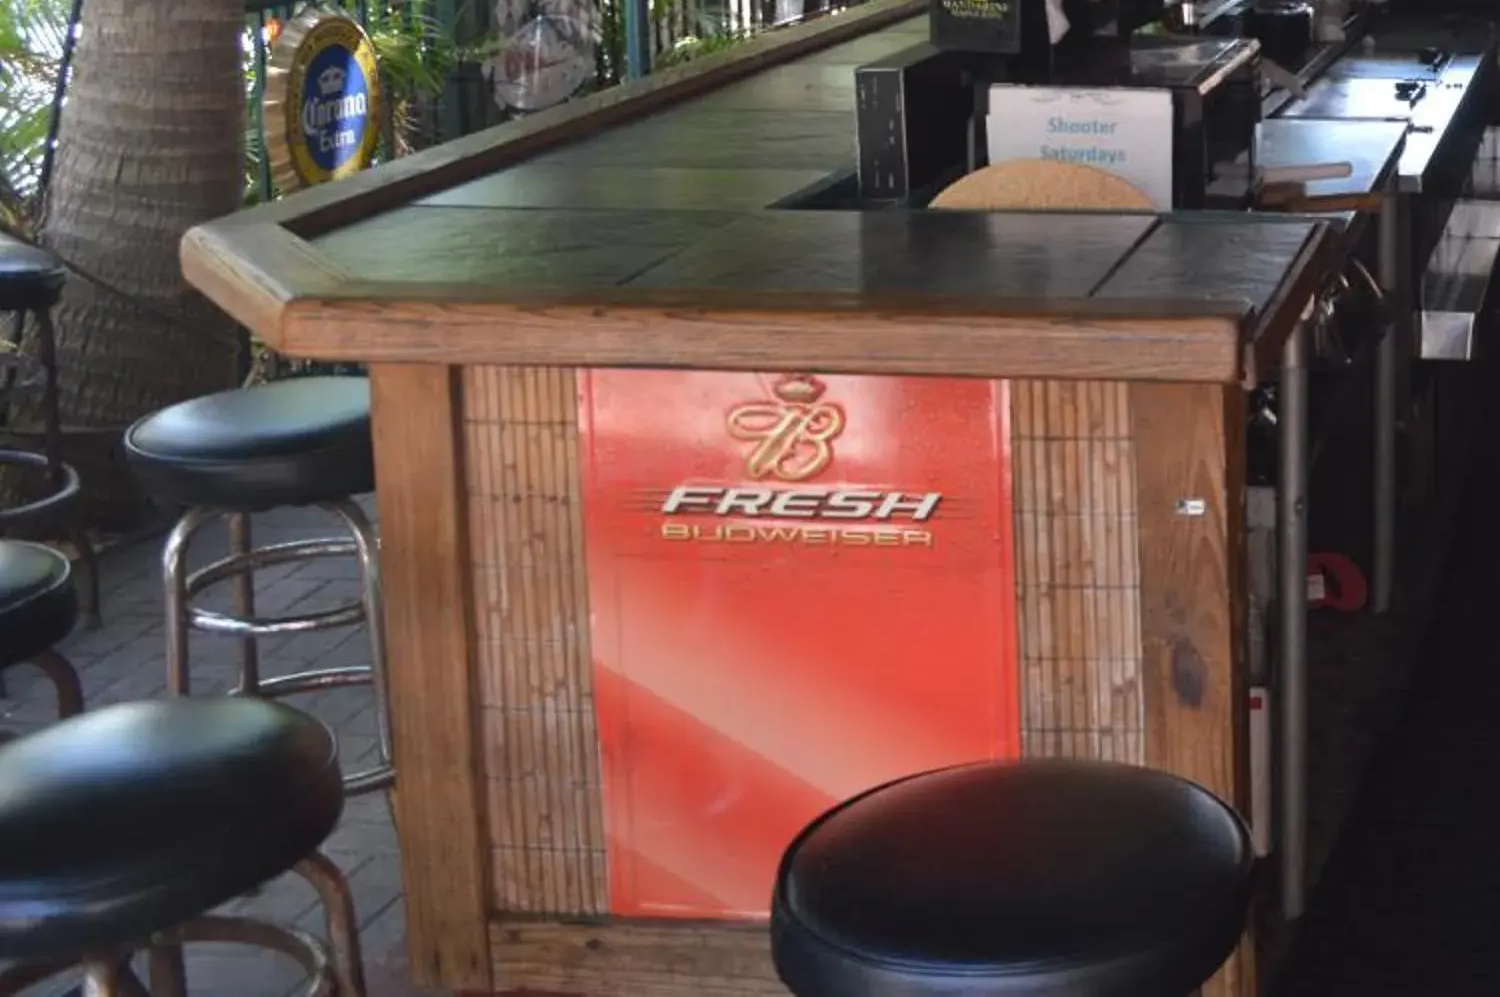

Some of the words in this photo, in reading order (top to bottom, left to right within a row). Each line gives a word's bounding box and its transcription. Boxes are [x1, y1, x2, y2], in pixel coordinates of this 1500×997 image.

[304, 92, 367, 136] Corona
[1047, 116, 1118, 135] Shooter
[1039, 144, 1128, 164] Saturdays
[661, 484, 942, 521] FRESH
[661, 522, 933, 548] BUDWEISER
